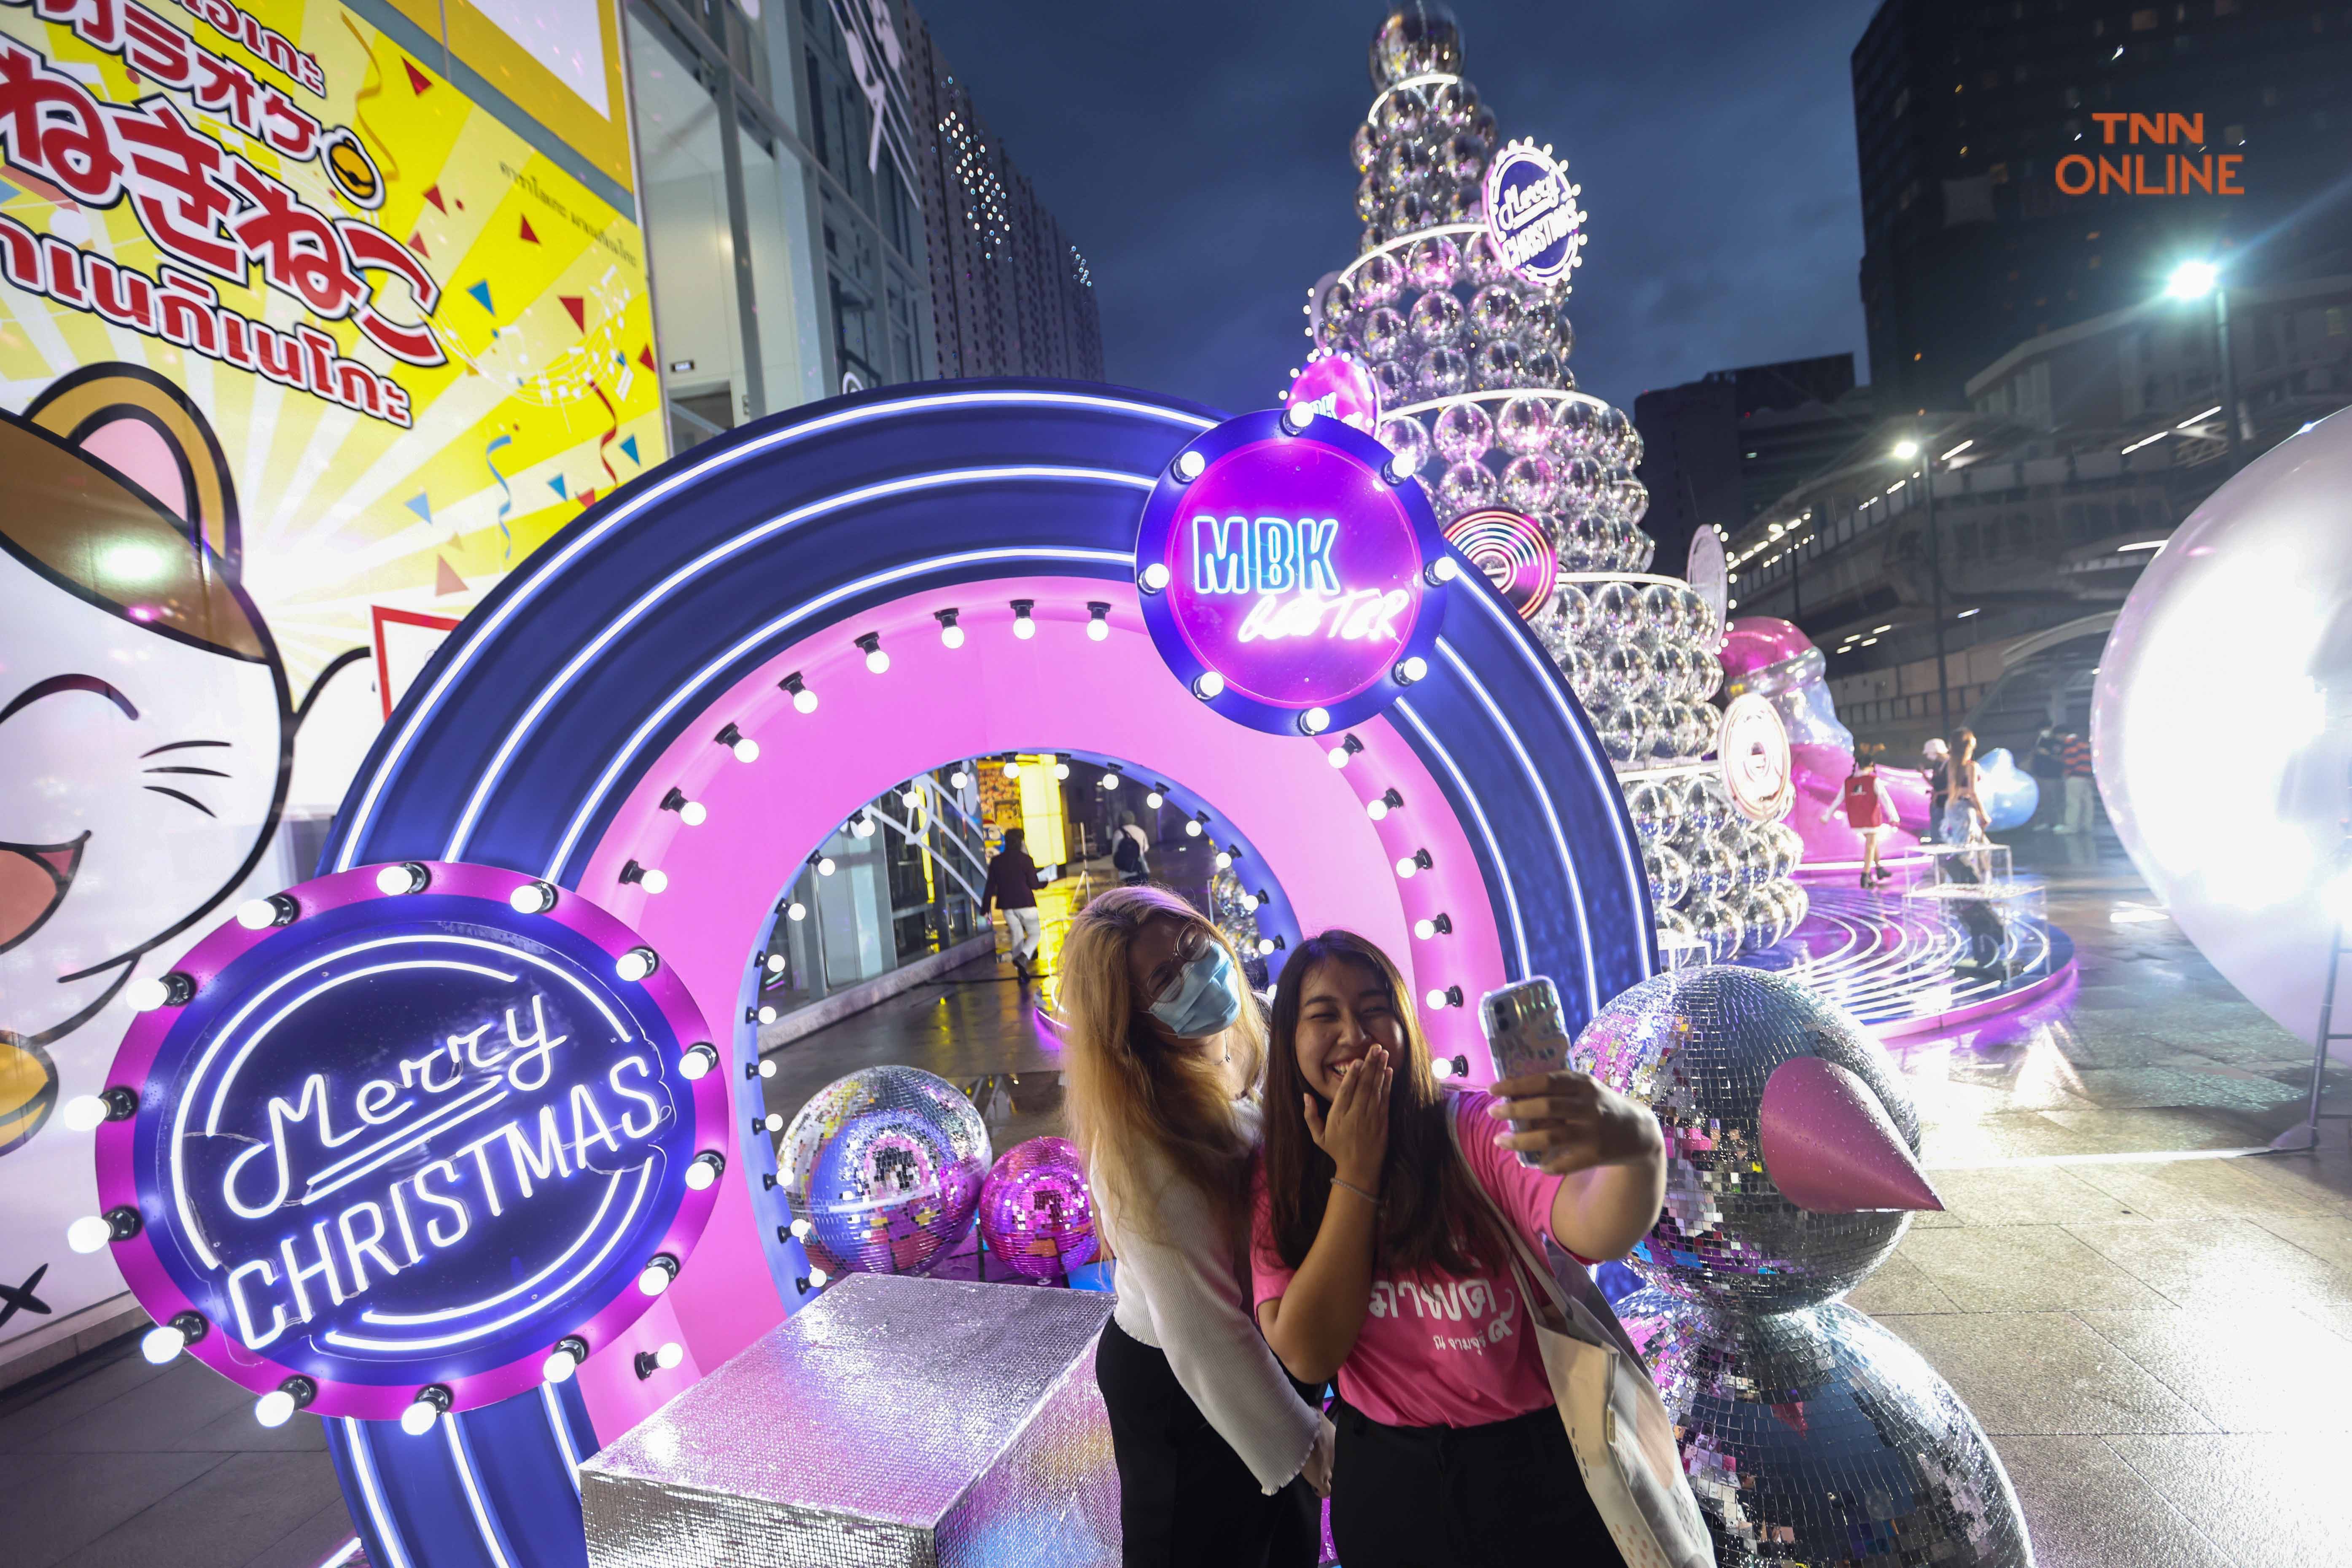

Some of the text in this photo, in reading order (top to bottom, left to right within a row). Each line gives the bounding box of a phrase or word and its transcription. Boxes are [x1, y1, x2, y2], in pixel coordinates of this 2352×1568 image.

[180, 0, 326, 98] อเกะ
[1502, 199, 1580, 270] CHRISTMAS
[1192, 516, 1340, 594] MBK
[223, 994, 568, 1218] Merry
[227, 1056, 659, 1350] CHRISTMAS
